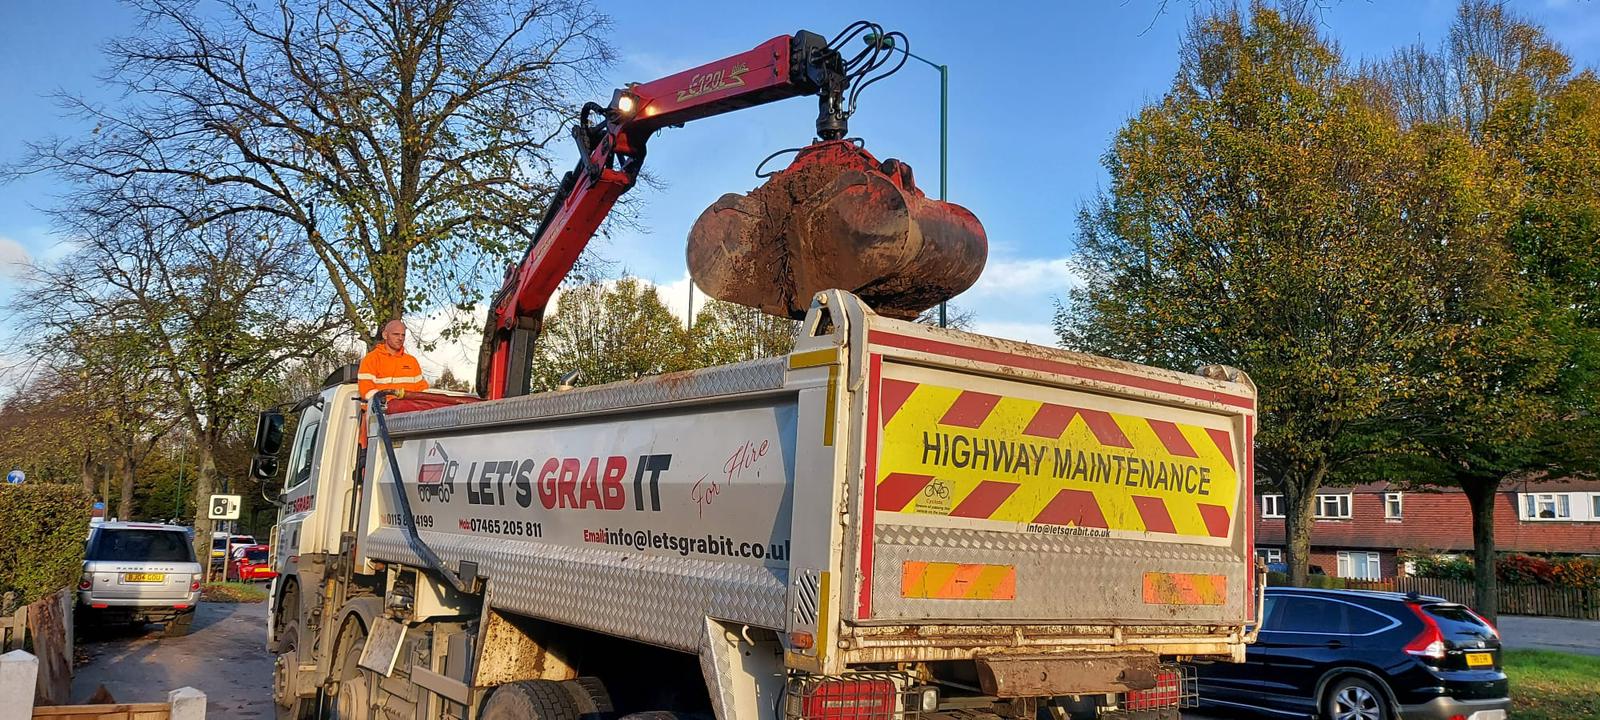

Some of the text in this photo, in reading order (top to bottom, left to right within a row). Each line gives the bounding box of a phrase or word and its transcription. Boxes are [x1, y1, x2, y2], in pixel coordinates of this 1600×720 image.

[467, 454, 673, 512] LET'S GRAB IT
[692, 439, 769, 520] For Hire
[922, 431, 1211, 496] HIGHWAY MAINTENANCE
[387, 513, 402, 526] 0115
[503, 520, 523, 536] 205
[526, 522, 542, 537] 811
